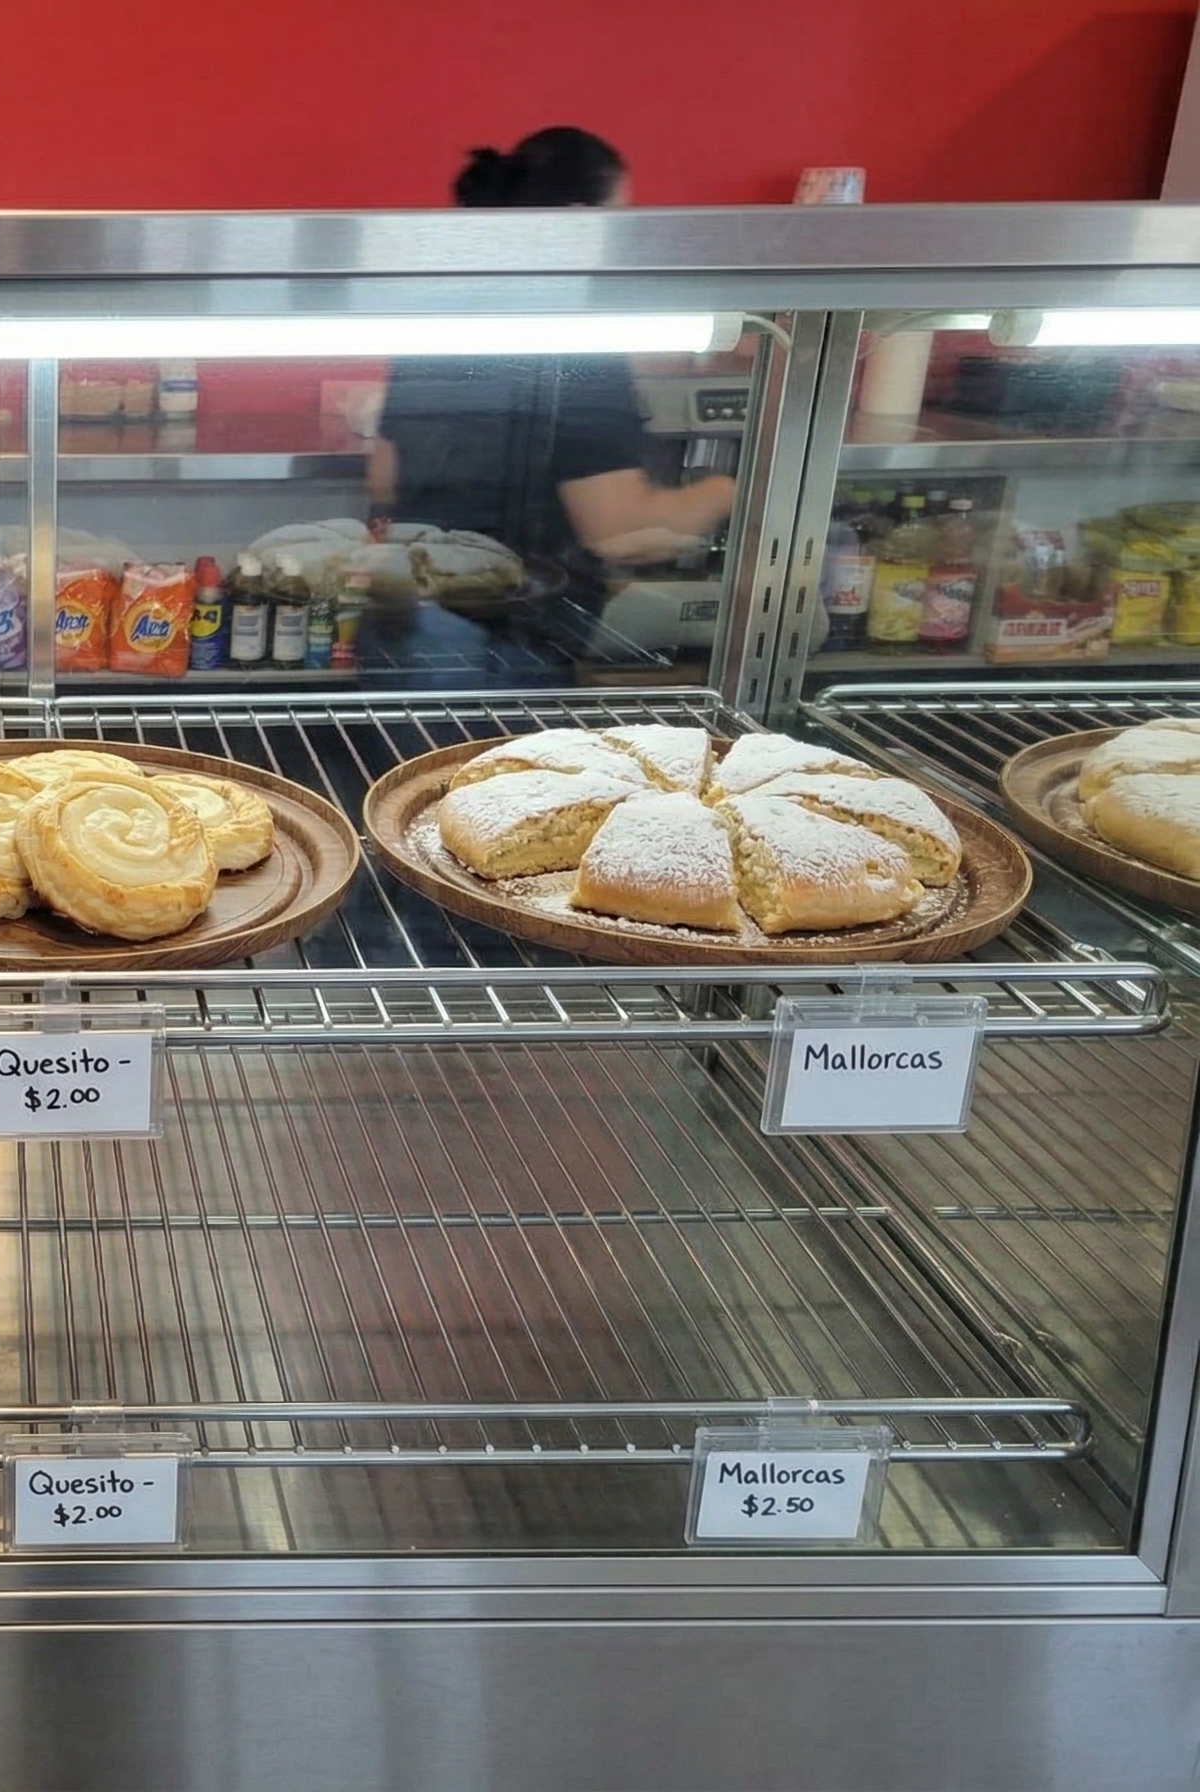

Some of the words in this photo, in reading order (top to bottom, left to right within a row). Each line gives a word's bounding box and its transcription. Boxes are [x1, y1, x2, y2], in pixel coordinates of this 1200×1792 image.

[804, 1043, 943, 1071] Mallorcas
[24, 1085, 101, 1113] $2.00
[718, 1462, 845, 1485] Mallorcas
[53, 1502, 123, 1528] $2.00
[741, 1493, 815, 1518] $2.50
